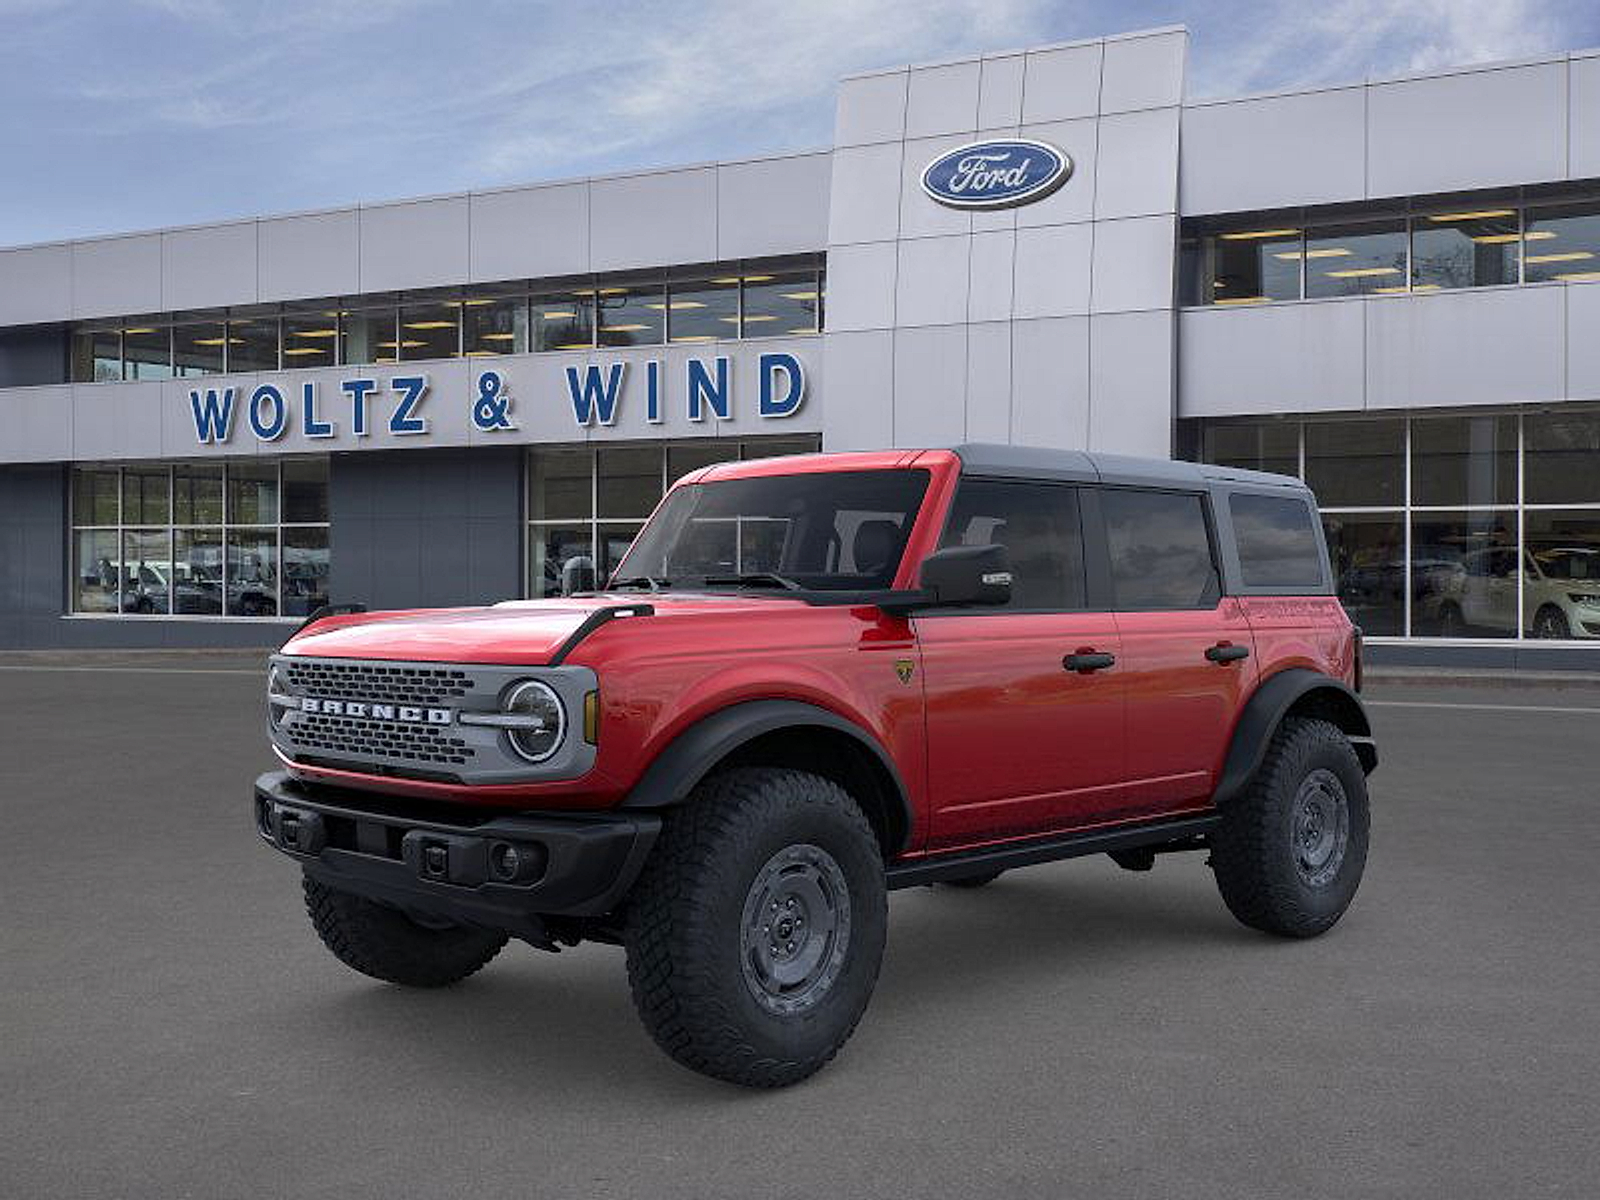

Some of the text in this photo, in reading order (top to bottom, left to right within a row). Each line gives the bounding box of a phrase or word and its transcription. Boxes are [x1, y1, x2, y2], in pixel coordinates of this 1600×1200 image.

[950, 152, 1031, 193] Ford
[189, 352, 806, 443] WOLTZ & WIND
[301, 698, 451, 724] BRONCO
